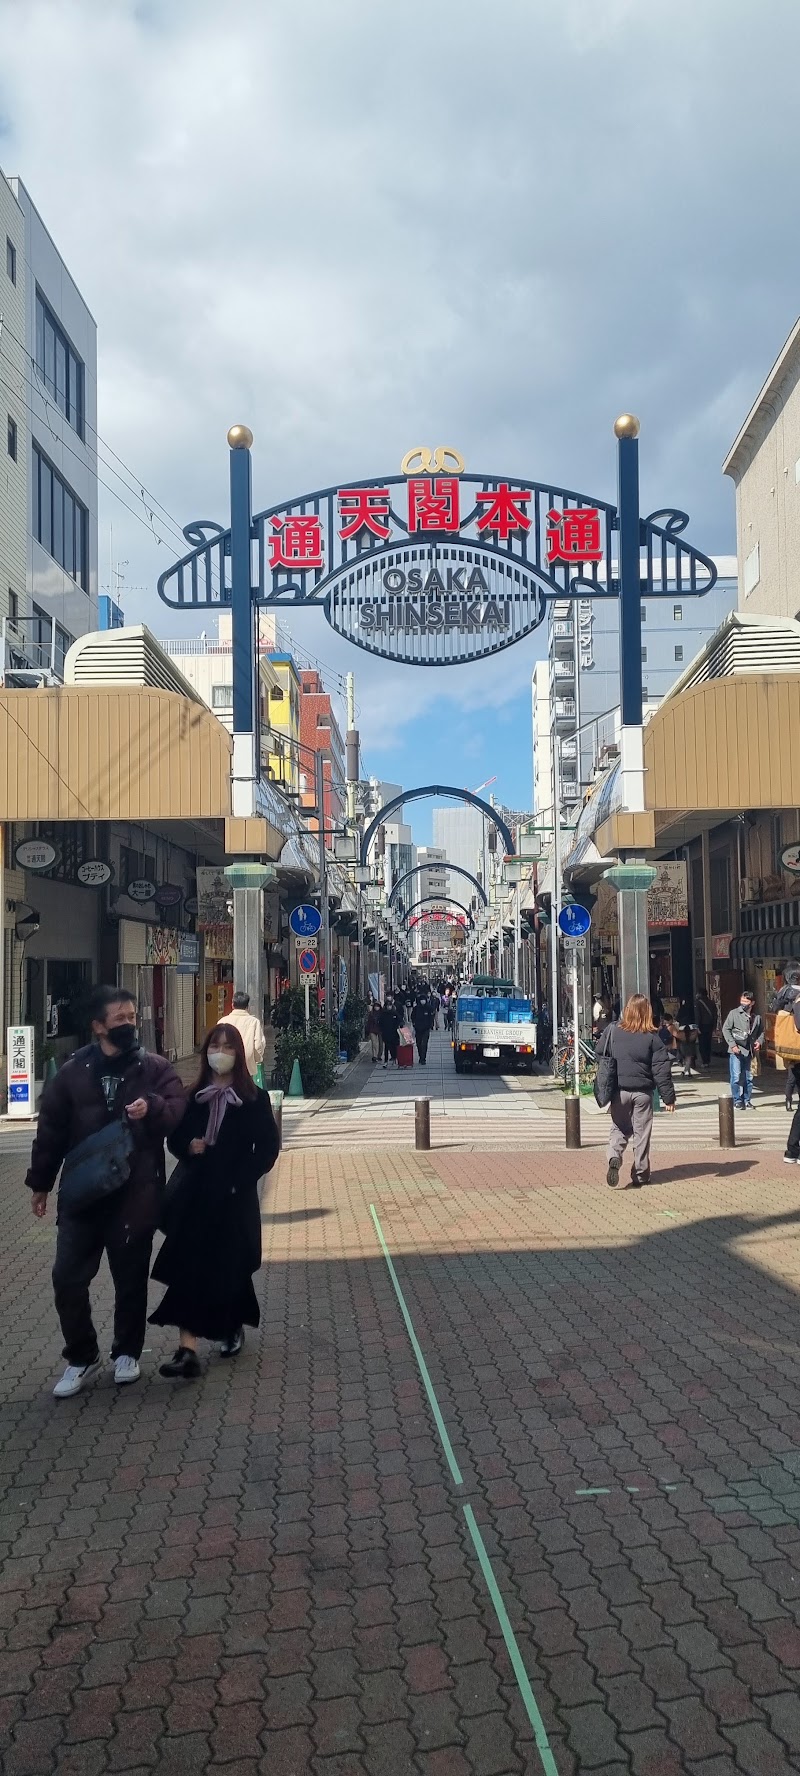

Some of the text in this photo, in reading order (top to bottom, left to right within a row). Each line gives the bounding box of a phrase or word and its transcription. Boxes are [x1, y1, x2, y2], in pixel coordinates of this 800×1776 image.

[268, 478, 603, 569] 通天閣本通
[382, 567, 489, 594] OSAKA
[359, 601, 511, 631] SHINSEKAI
[12, 1035, 26, 1069] 通天閣
